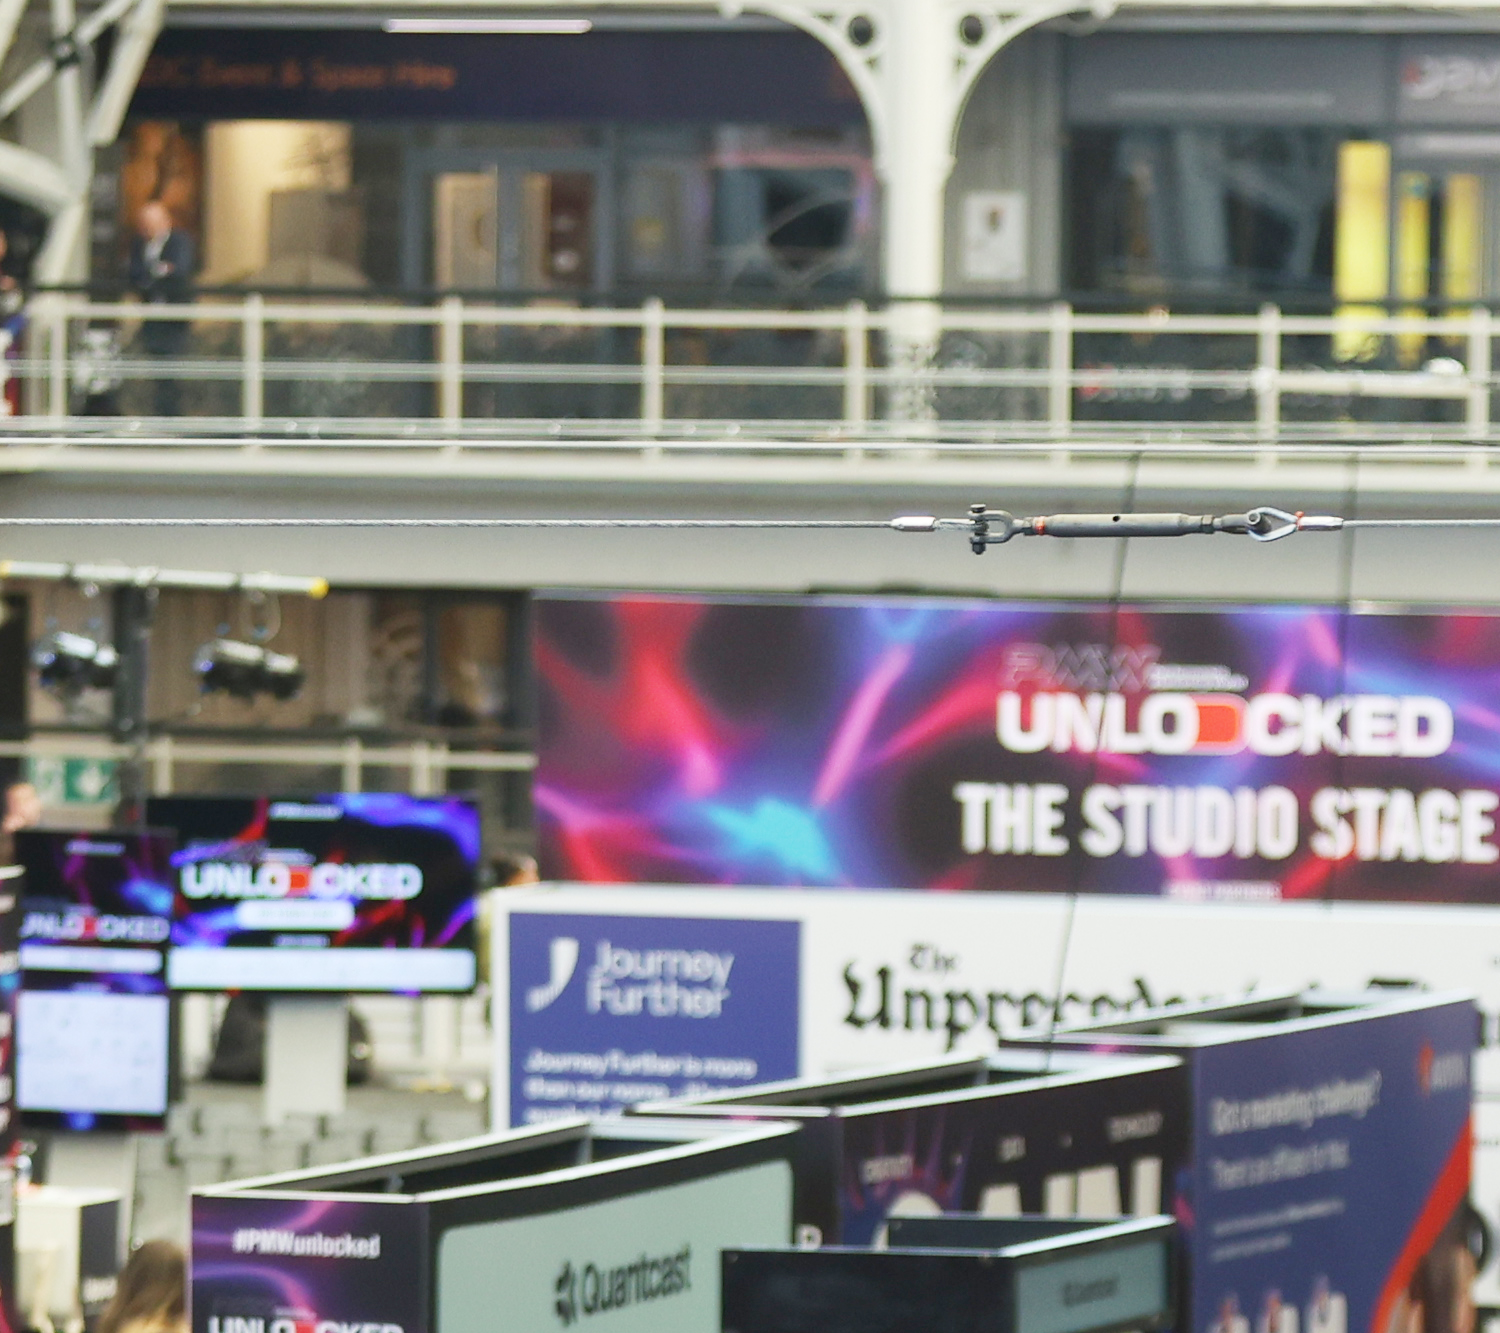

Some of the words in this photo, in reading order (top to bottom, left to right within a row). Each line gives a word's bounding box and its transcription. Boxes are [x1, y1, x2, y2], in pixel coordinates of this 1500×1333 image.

[995, 690, 1455, 759] UNLOCKED
[952, 781, 1071, 857] THE
[1078, 783, 1299, 861] STUDIO
[180, 862, 424, 899] UNLOCKED
[595, 938, 736, 990] Journey
[907, 942, 960, 974] The
[585, 973, 731, 1019] Further
[231, 1227, 382, 1260] #PMWunlocked
[580, 1241, 692, 1318] Quantcast
